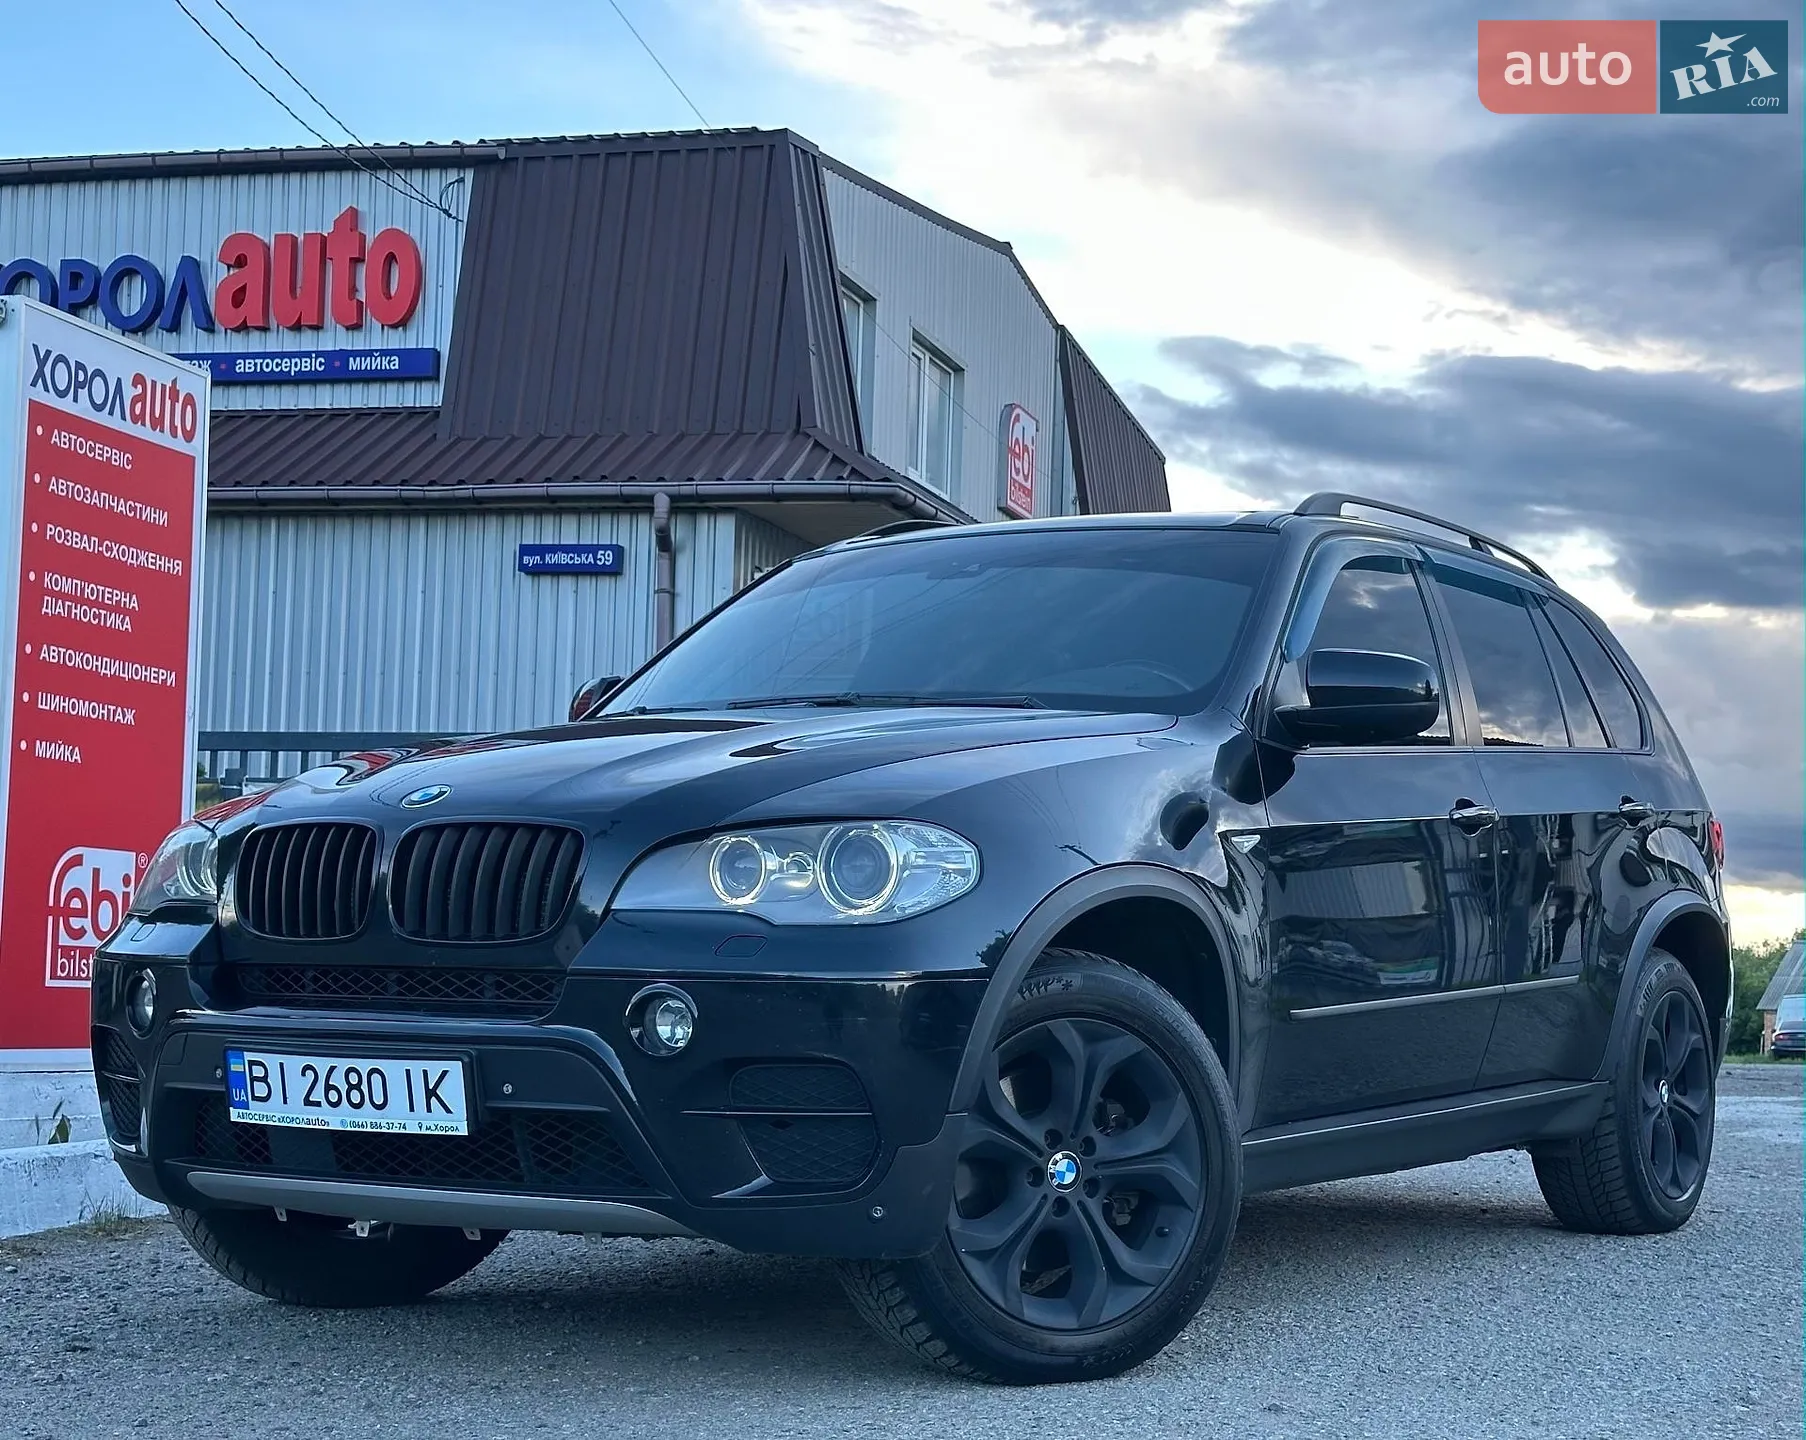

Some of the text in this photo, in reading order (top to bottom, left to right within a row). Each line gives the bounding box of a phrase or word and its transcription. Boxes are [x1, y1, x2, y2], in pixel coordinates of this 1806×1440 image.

[235, 352, 326, 376] автосервіс
[348, 351, 400, 372] мийка
[51, 429, 133, 470] АВТОСЕРВІС
[48, 476, 168, 527] АВТОЗАПЧАСТИНИ
[46, 523, 182, 576] РОЗВАЛ-СХОДЖЕННЯ
[523, 550, 613, 567] вул. КИЇВСЬКА 59
[41, 595, 132, 633] ДІАГНОСТИКА
[39, 643, 177, 688] АВТОКОНДИЦІОНЕРИ
[37, 691, 137, 727] ШИНОМОНТАЖ
[35, 739, 82, 764] МИЙКА
[232, 1088, 247, 1102] UA
[301, 1063, 389, 1111] 2680
[405, 1068, 454, 1115] IK
